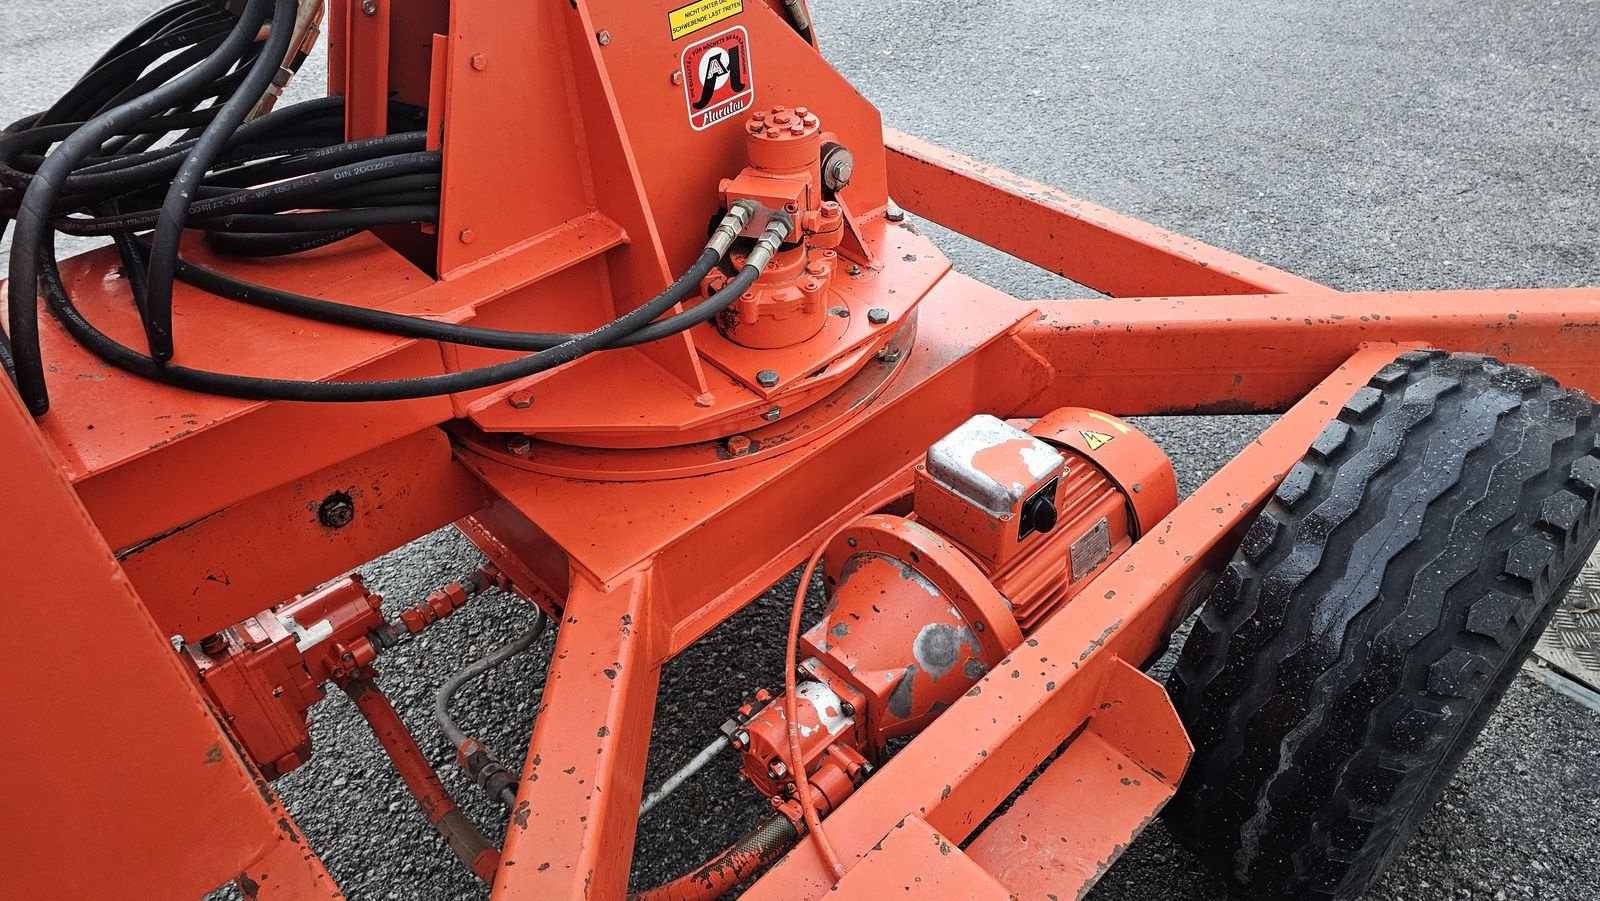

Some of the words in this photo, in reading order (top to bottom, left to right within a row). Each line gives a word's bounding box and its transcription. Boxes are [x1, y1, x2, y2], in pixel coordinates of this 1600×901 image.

[672, 15, 708, 34] SCHWEBENDE
[708, 9, 722, 19] LAST
[722, 1, 741, 13] TRETEN
[684, 8, 701, 18] NICHT
[701, 1, 719, 12] UNTER
